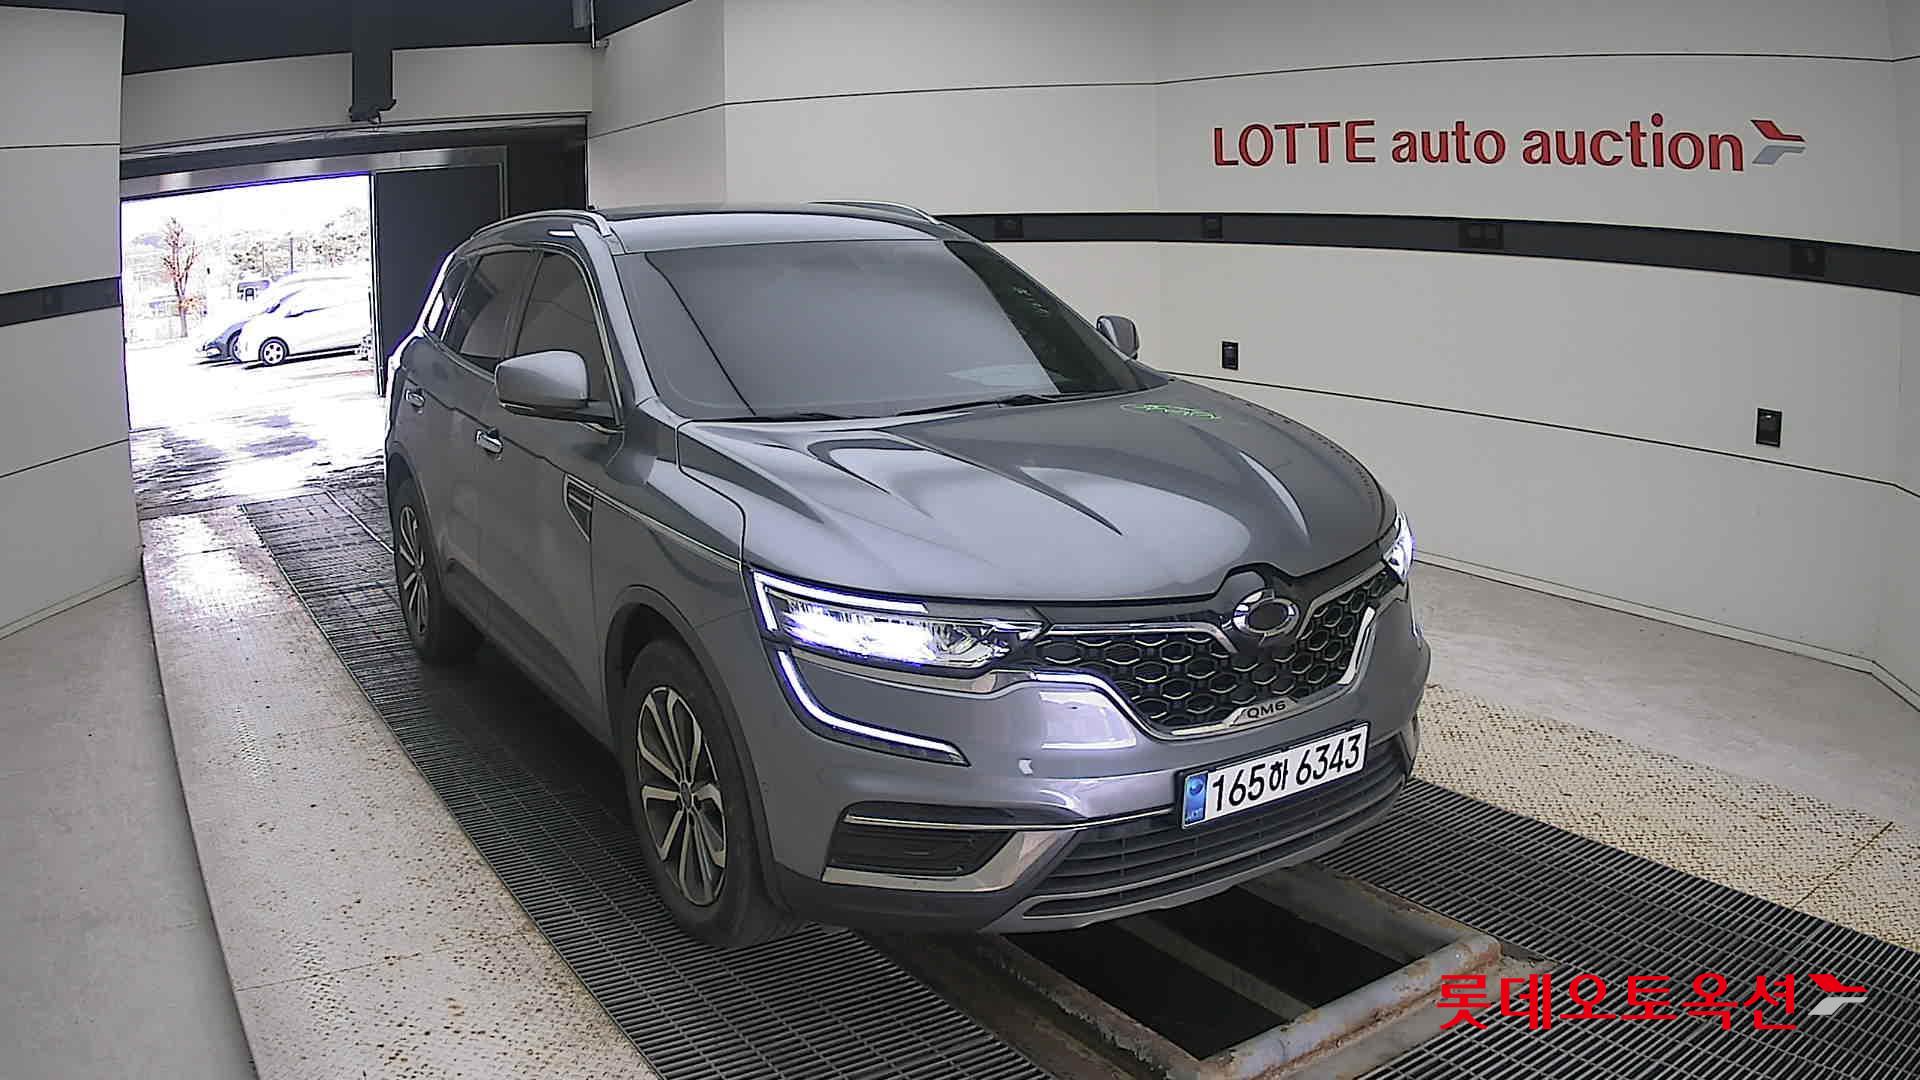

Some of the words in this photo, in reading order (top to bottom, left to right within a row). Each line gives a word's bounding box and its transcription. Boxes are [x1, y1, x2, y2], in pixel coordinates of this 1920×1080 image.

[1213, 119, 1377, 167] LOTTE
[1391, 120, 1507, 165] auto
[1522, 113, 1745, 172] auction
[1246, 701, 1287, 719] QM6
[1212, 758, 1289, 812] 165하
[1295, 734, 1362, 786] 6343
